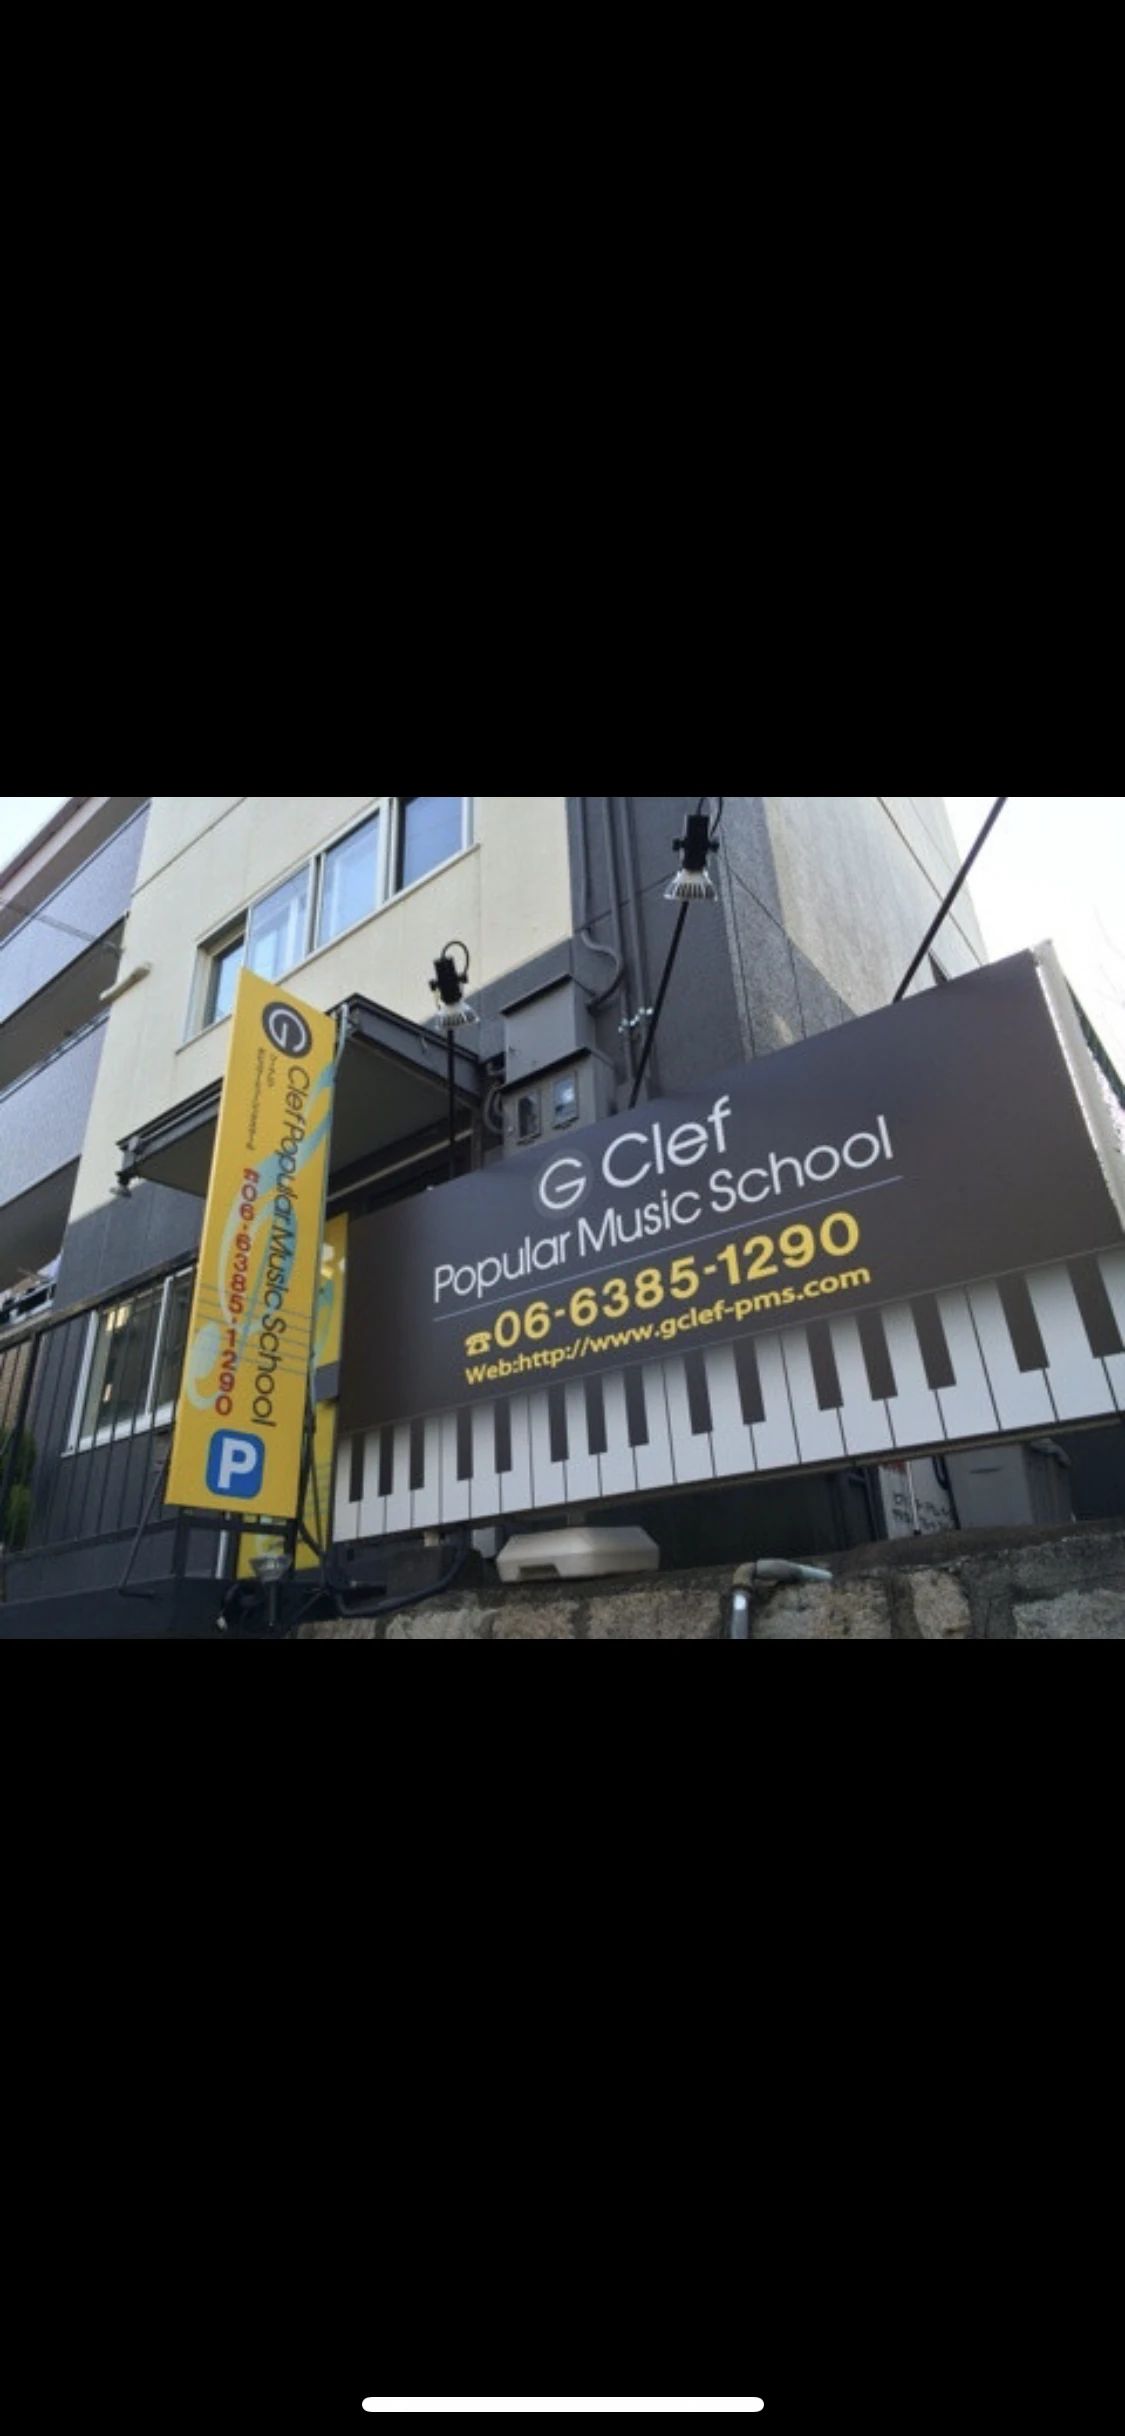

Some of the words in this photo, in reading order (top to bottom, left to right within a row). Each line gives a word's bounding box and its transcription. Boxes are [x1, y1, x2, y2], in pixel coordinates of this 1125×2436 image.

[284, 1065, 311, 1125] Clef
[270, 1121, 303, 1226] Popular
[538, 1157, 587, 1211] G
[602, 1095, 732, 1188] Clef
[433, 1229, 574, 1303] Popular
[578, 1189, 702, 1258] Music
[708, 1114, 894, 1213] School
[262, 1224, 294, 1311] Music
[493, 1211, 860, 1350] 06-6385-1290
[250, 1312, 285, 1427] School
[217, 1437, 258, 1489] P
